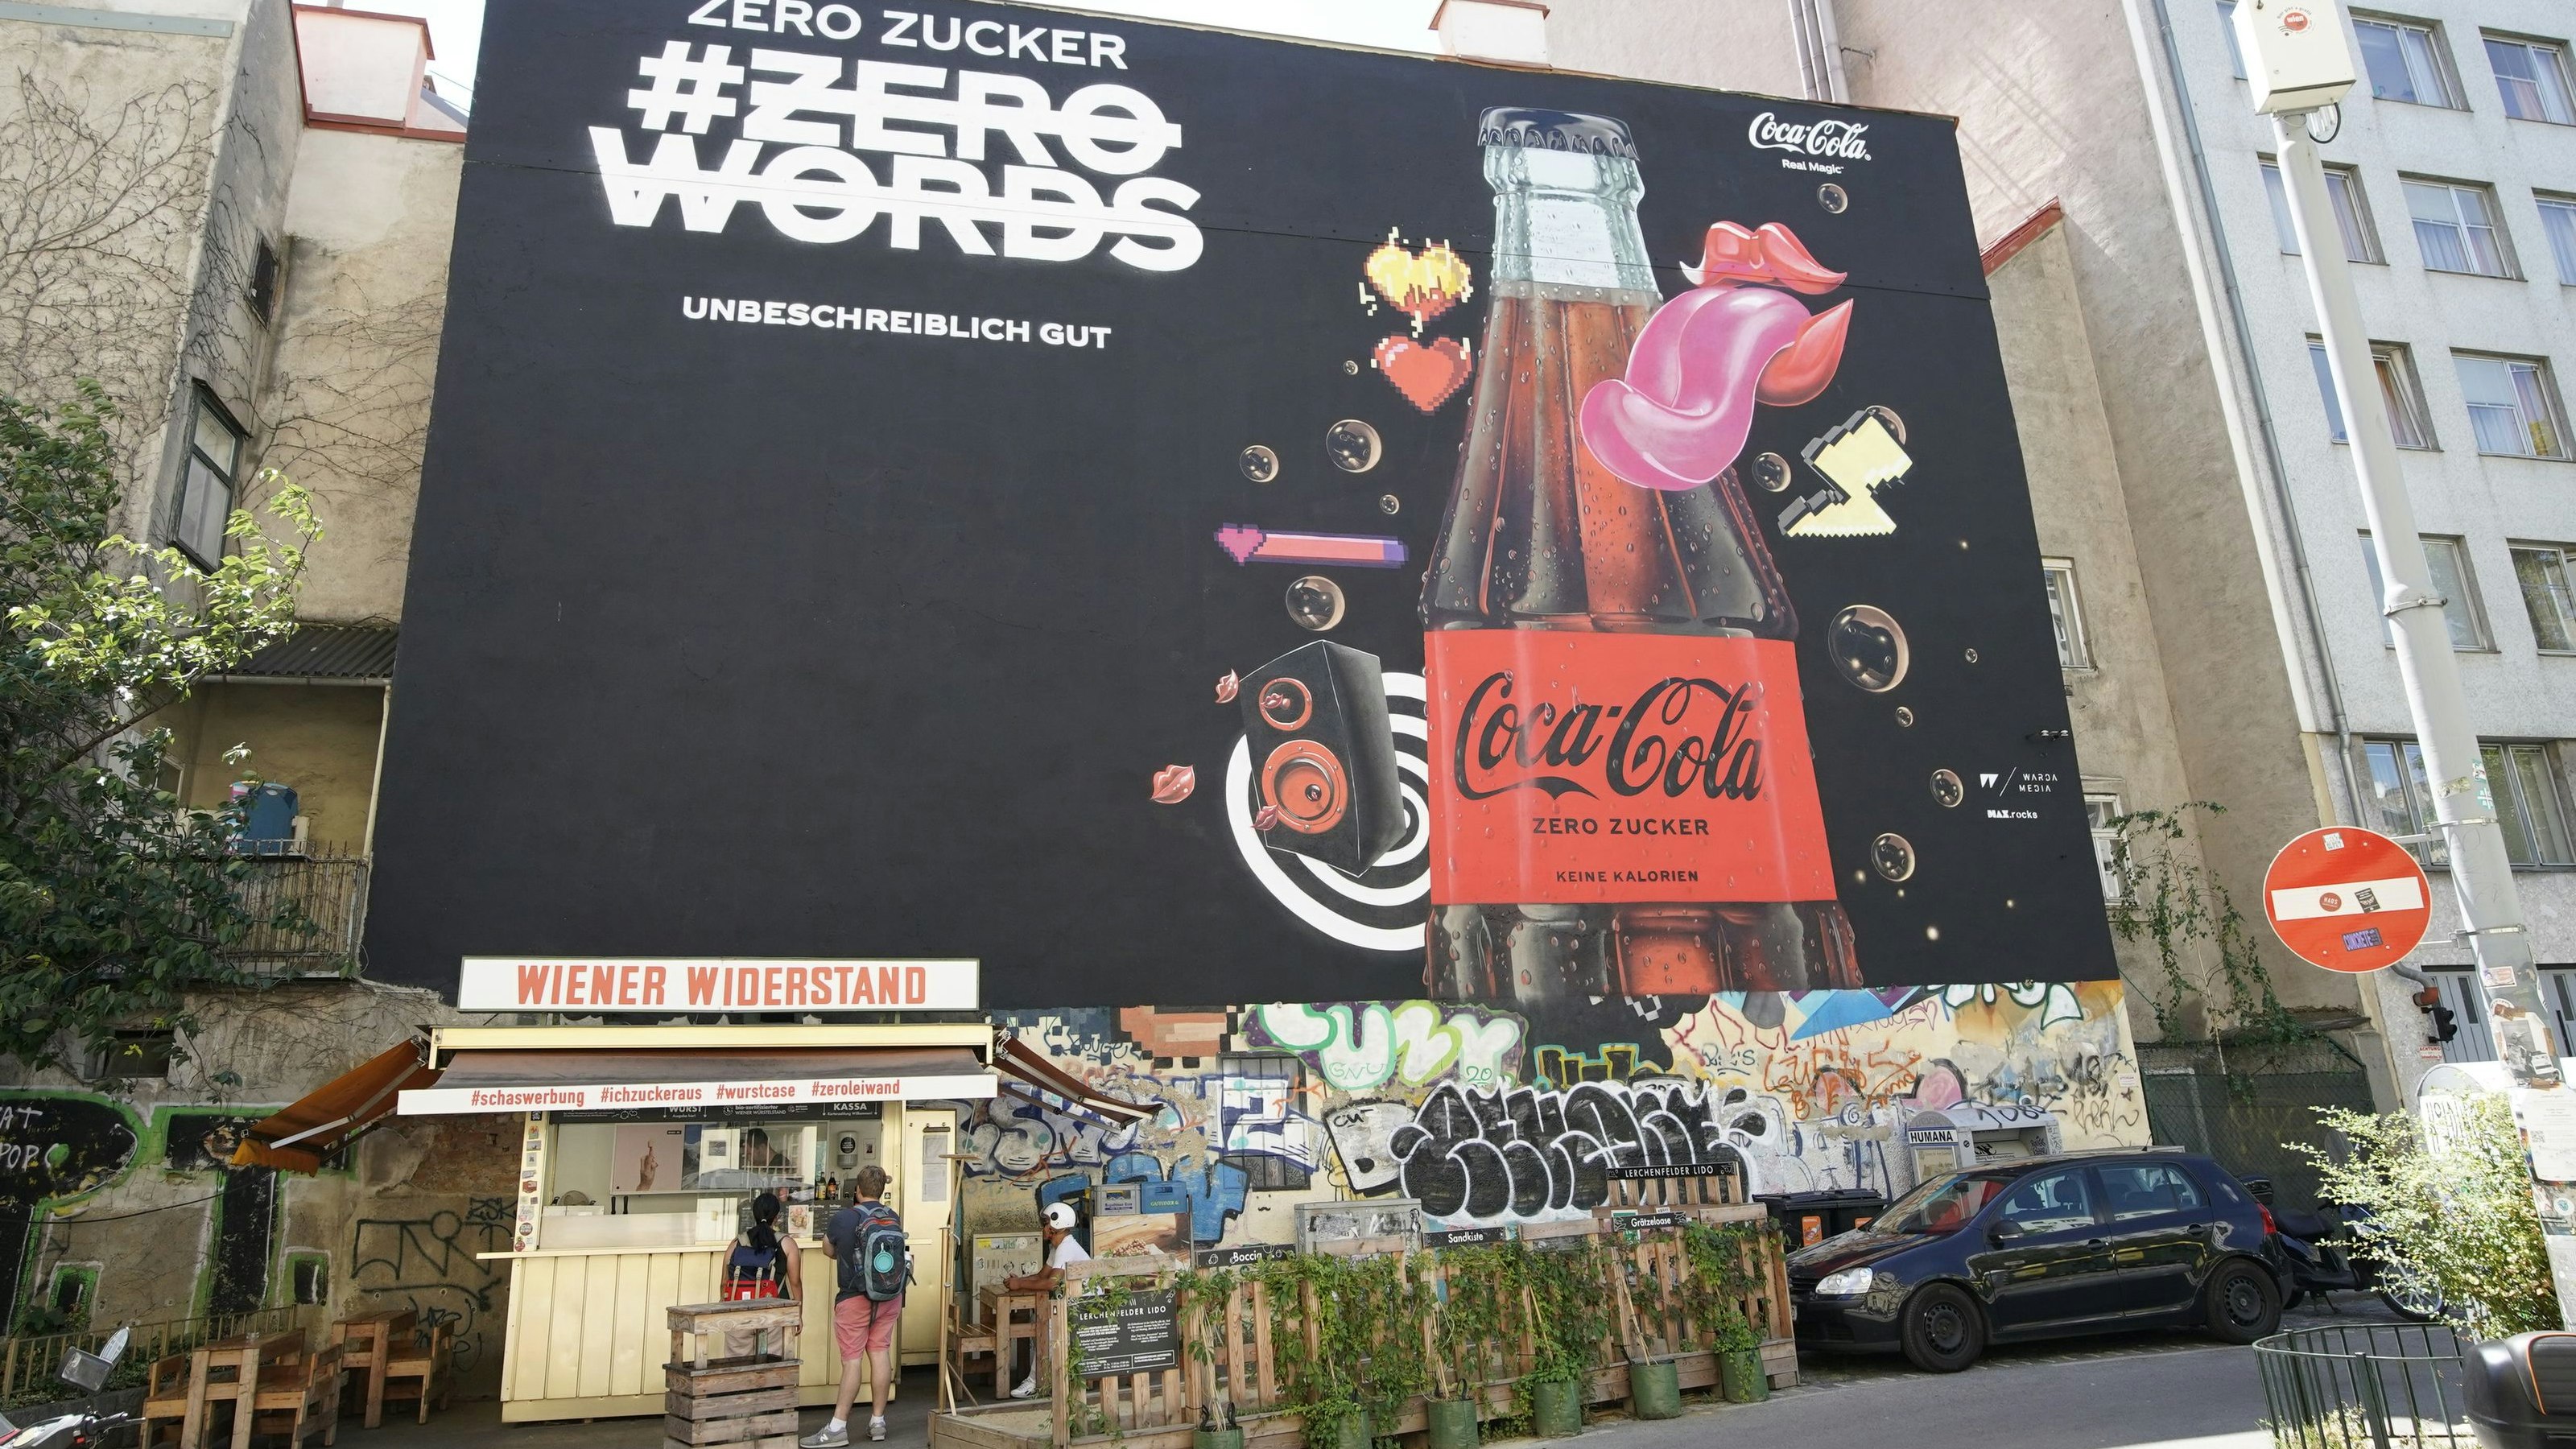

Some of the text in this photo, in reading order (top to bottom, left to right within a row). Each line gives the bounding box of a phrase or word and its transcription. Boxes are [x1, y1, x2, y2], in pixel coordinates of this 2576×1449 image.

[687, 0, 1128, 70] ZERO ZUCKER
[627, 40, 1182, 175] #ZERO
[1781, 159, 1844, 175] Real Magic
[588, 126, 1204, 272] WORDS
[682, 296, 1112, 349] UNBESCHREIBLICH GUT
[1454, 671, 1768, 802] Coca-Cola
[1533, 817, 1709, 836] ZERO ZUCKER
[1556, 870, 1699, 882] KEINE KALORIEN
[518, 964, 927, 1006] WIENER WIDERSTAND
[1466, 1066, 1492, 1082] 20
[471, 1080, 901, 1108] #schaswerbung #ichzuckeraus #wurstcase #zeroleiwand
[833, 1103, 867, 1111] KASSA
[1910, 1131, 1954, 1143] HUMANA
[1624, 1166, 1713, 1178] LERCHENFELDER LIDO
[1631, 1216, 1671, 1228] Grätzeloase
[1447, 1232, 1484, 1243] Sandkiste
[1232, 1250, 1262, 1263] Boccia
[819, 1433, 828, 1443] N
